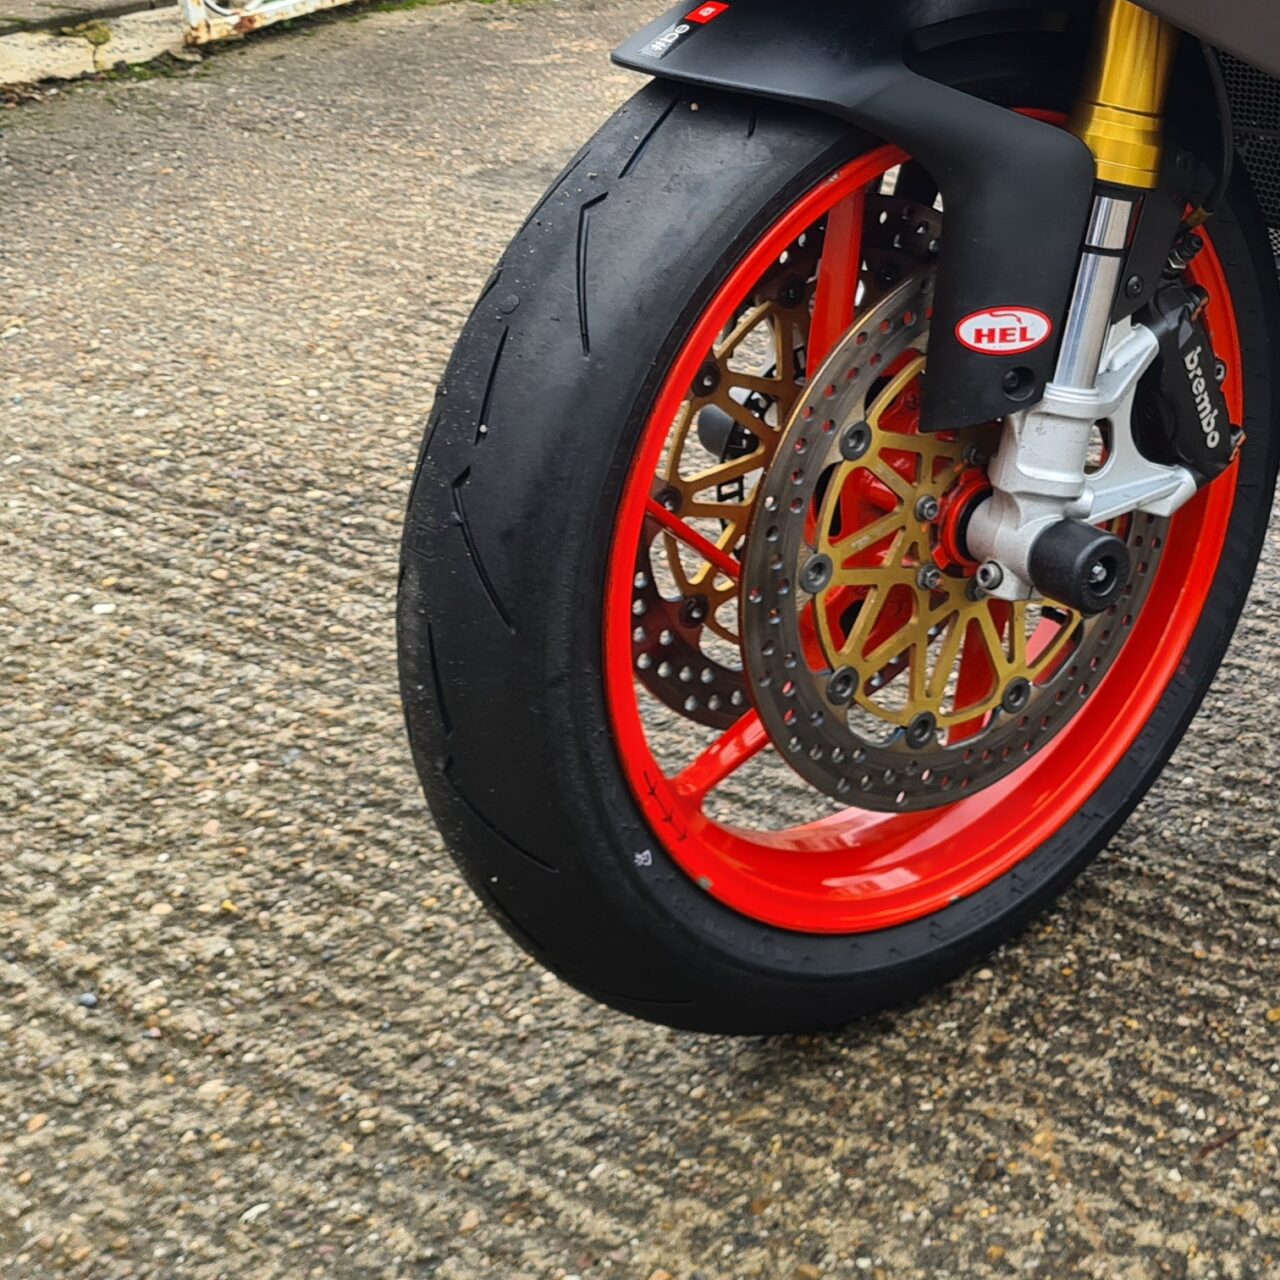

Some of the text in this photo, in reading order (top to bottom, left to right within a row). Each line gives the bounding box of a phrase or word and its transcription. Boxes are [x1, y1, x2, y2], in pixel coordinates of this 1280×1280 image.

[651, 23, 690, 52] #be
[698, 6, 716, 17] a
[973, 326, 1036, 344] HEL
[1184, 345, 1220, 449] brembo
